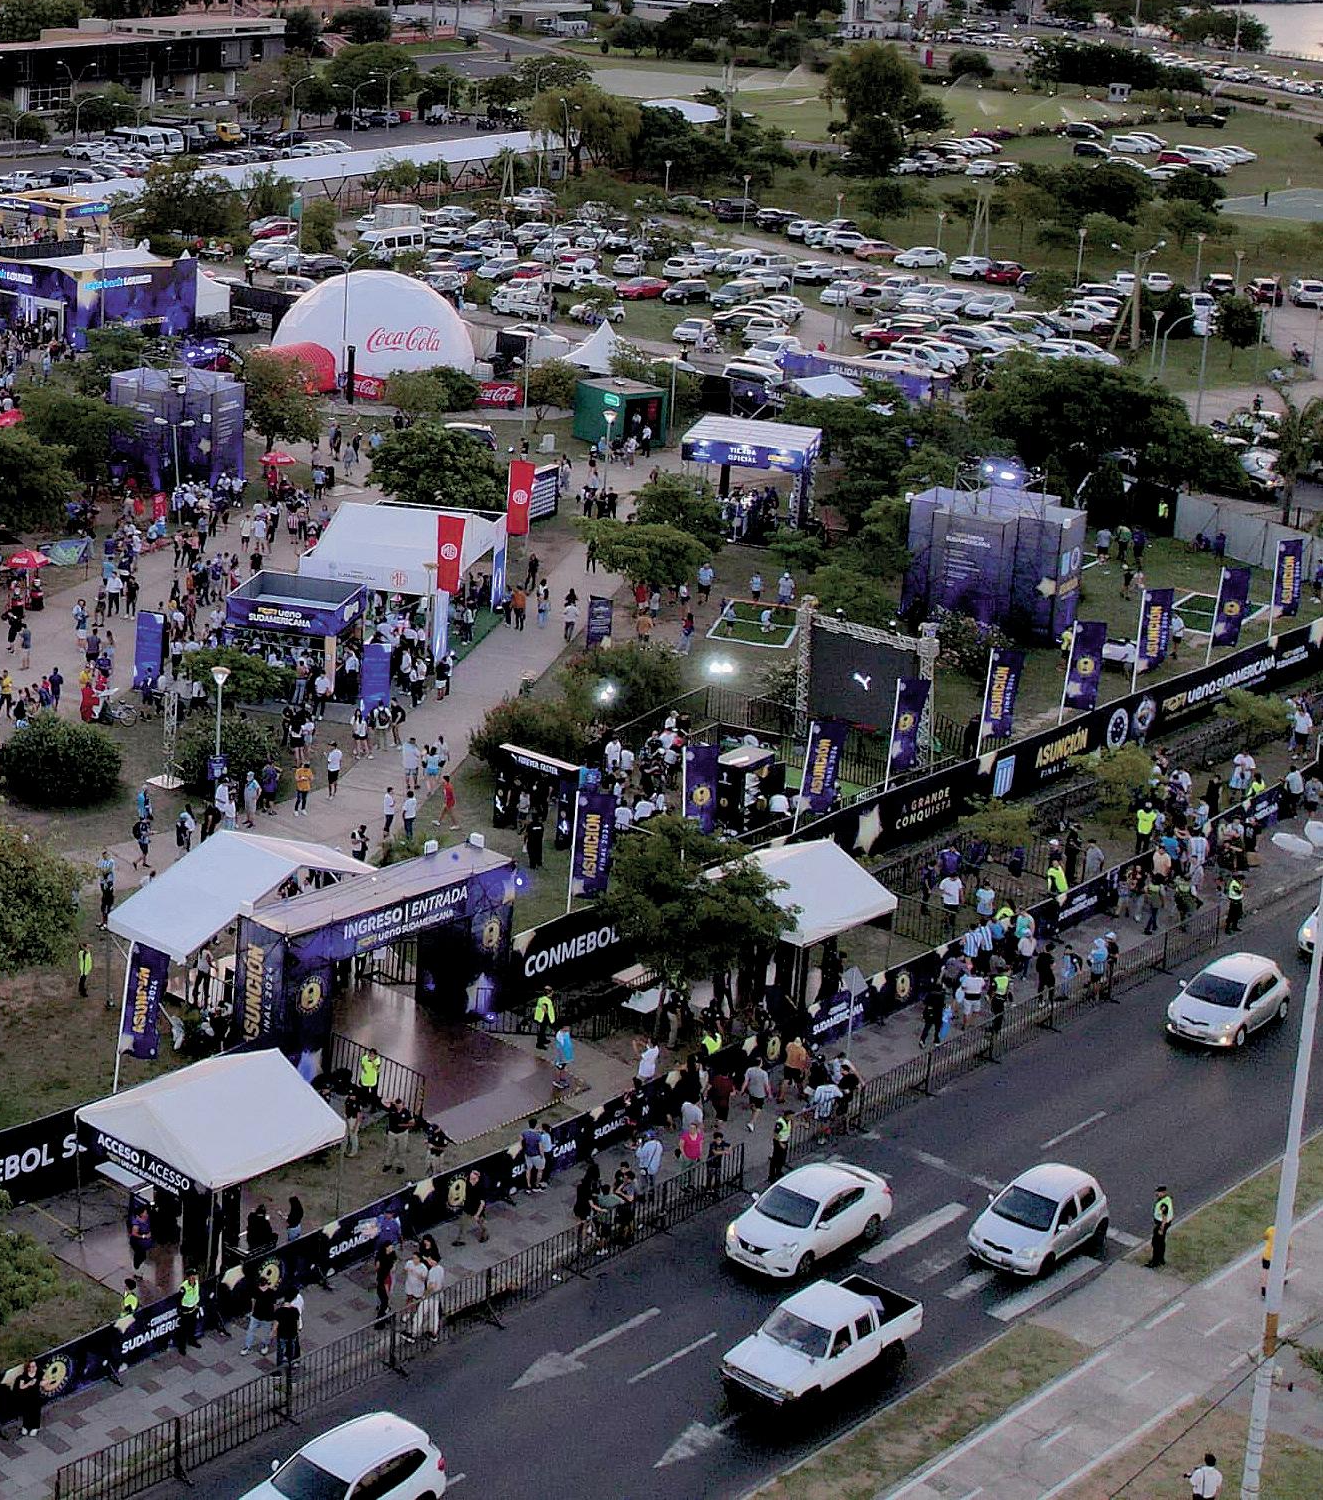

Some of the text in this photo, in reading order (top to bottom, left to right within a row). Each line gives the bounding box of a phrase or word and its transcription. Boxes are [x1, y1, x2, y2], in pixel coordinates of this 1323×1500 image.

[248, 613, 311, 628] SUDAMERICANA
[1035, 725, 1089, 769] ASUNCIÓN
[895, 799, 951, 830] CONQUISTA
[911, 786, 951, 811] GRANDE
[582, 814, 602, 879] ASUNCIÓN
[343, 906, 403, 940] INGRESO
[411, 885, 469, 917] ENTRADA
[524, 925, 621, 978] CONMEBOL
[98, 1133, 140, 1164] ACCESO
[148, 1160, 190, 1191] ACESSO
[121, 1316, 181, 1354] SUDAMERIC
